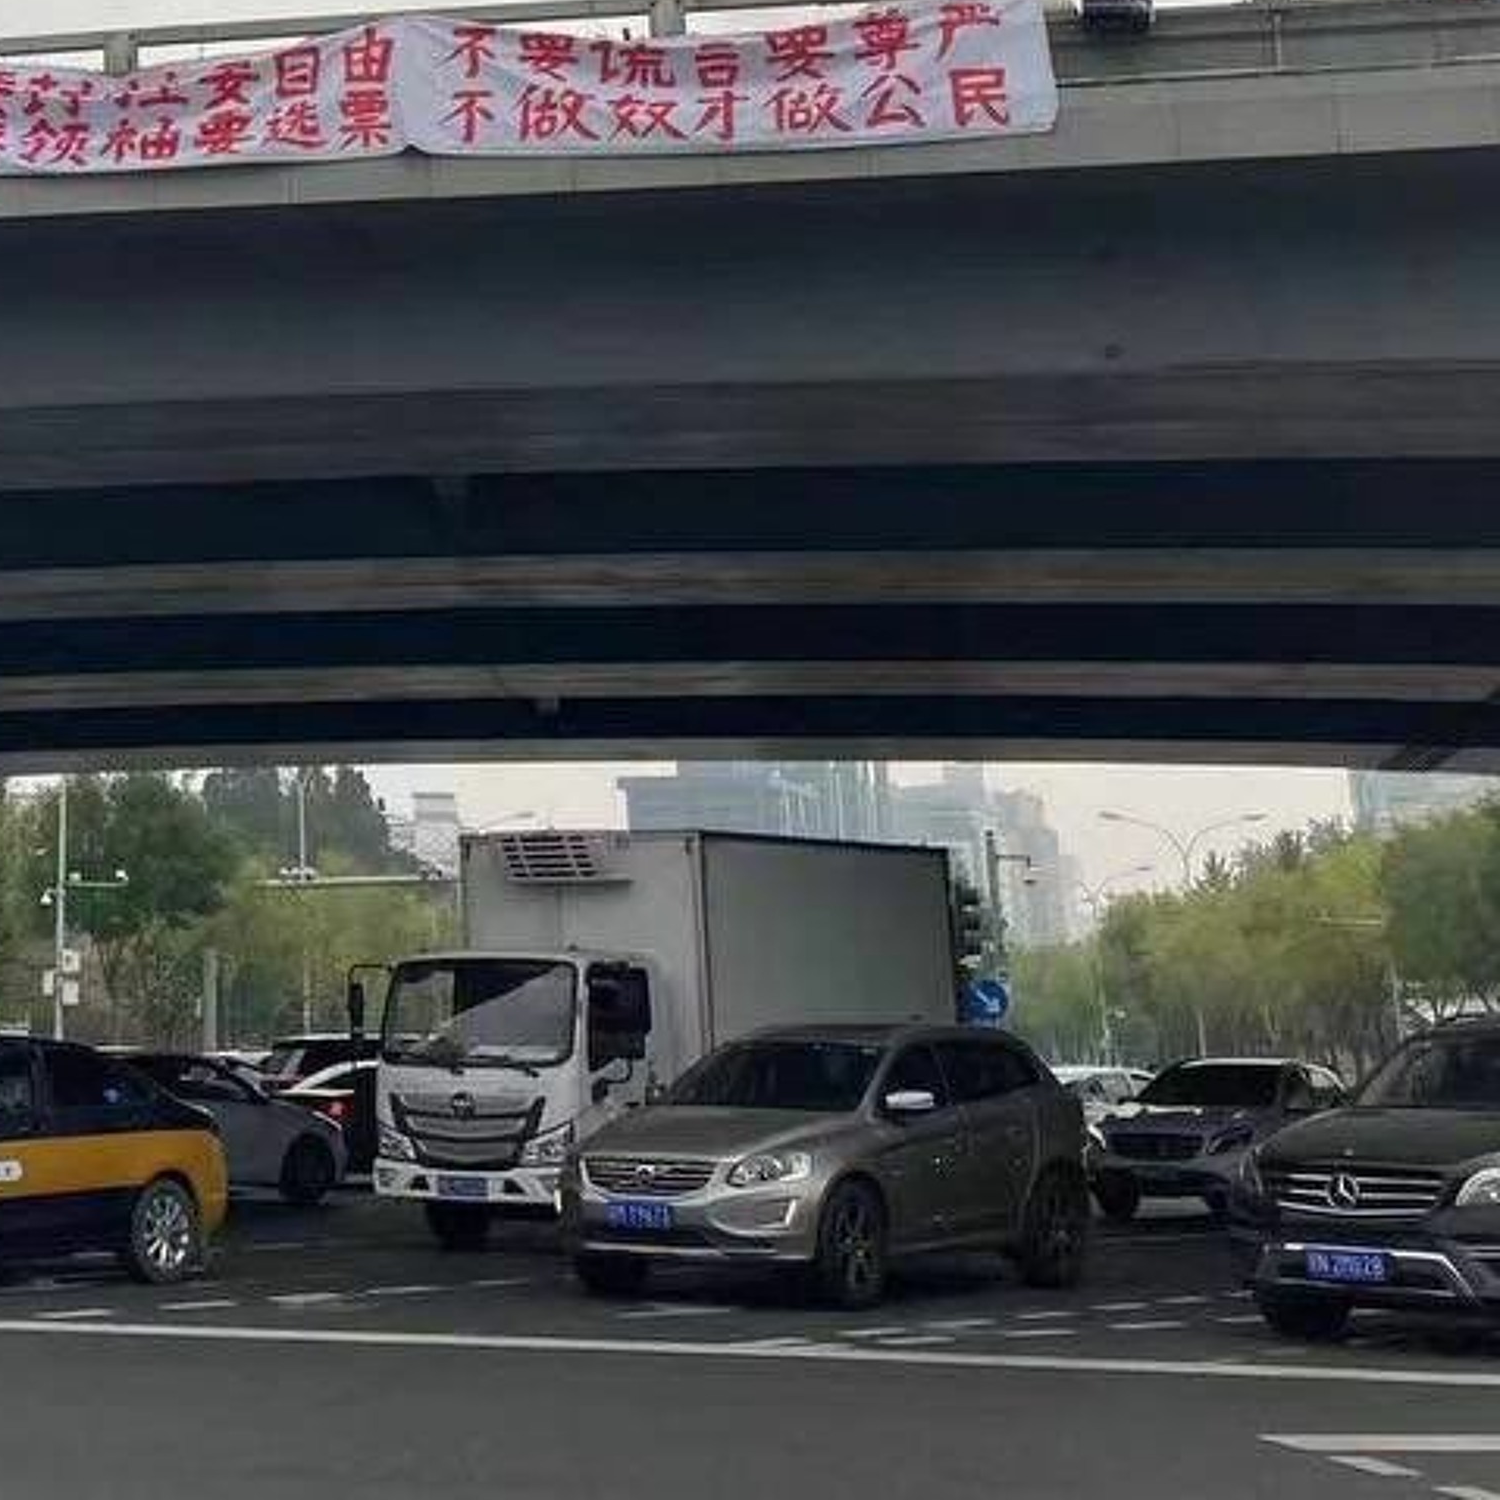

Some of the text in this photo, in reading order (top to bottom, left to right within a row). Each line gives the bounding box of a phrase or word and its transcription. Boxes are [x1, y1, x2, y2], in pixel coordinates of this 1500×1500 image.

[440, 68, 1008, 145] 不做奴才做公民
